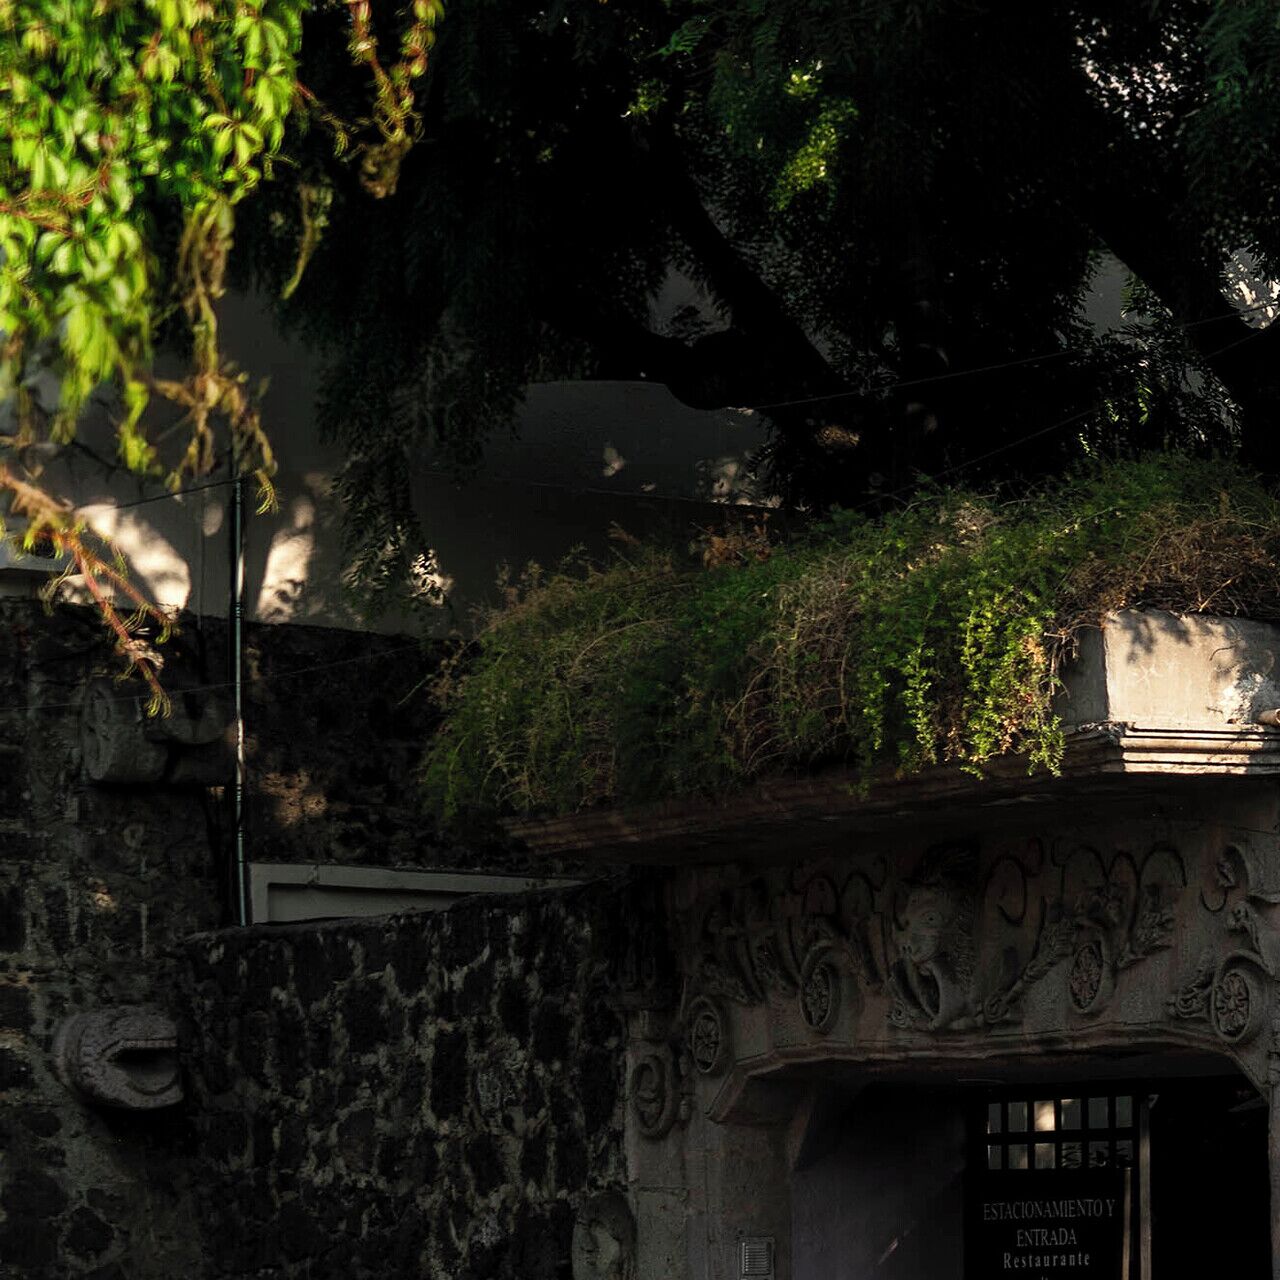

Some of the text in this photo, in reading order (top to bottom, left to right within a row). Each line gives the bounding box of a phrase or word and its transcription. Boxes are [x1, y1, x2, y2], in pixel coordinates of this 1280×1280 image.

[983, 1198, 1117, 1221] ESTACIONAMIENTO Y
[1016, 1228, 1077, 1247] ENTRADA
[1003, 1252, 1091, 1269] Restaurante
